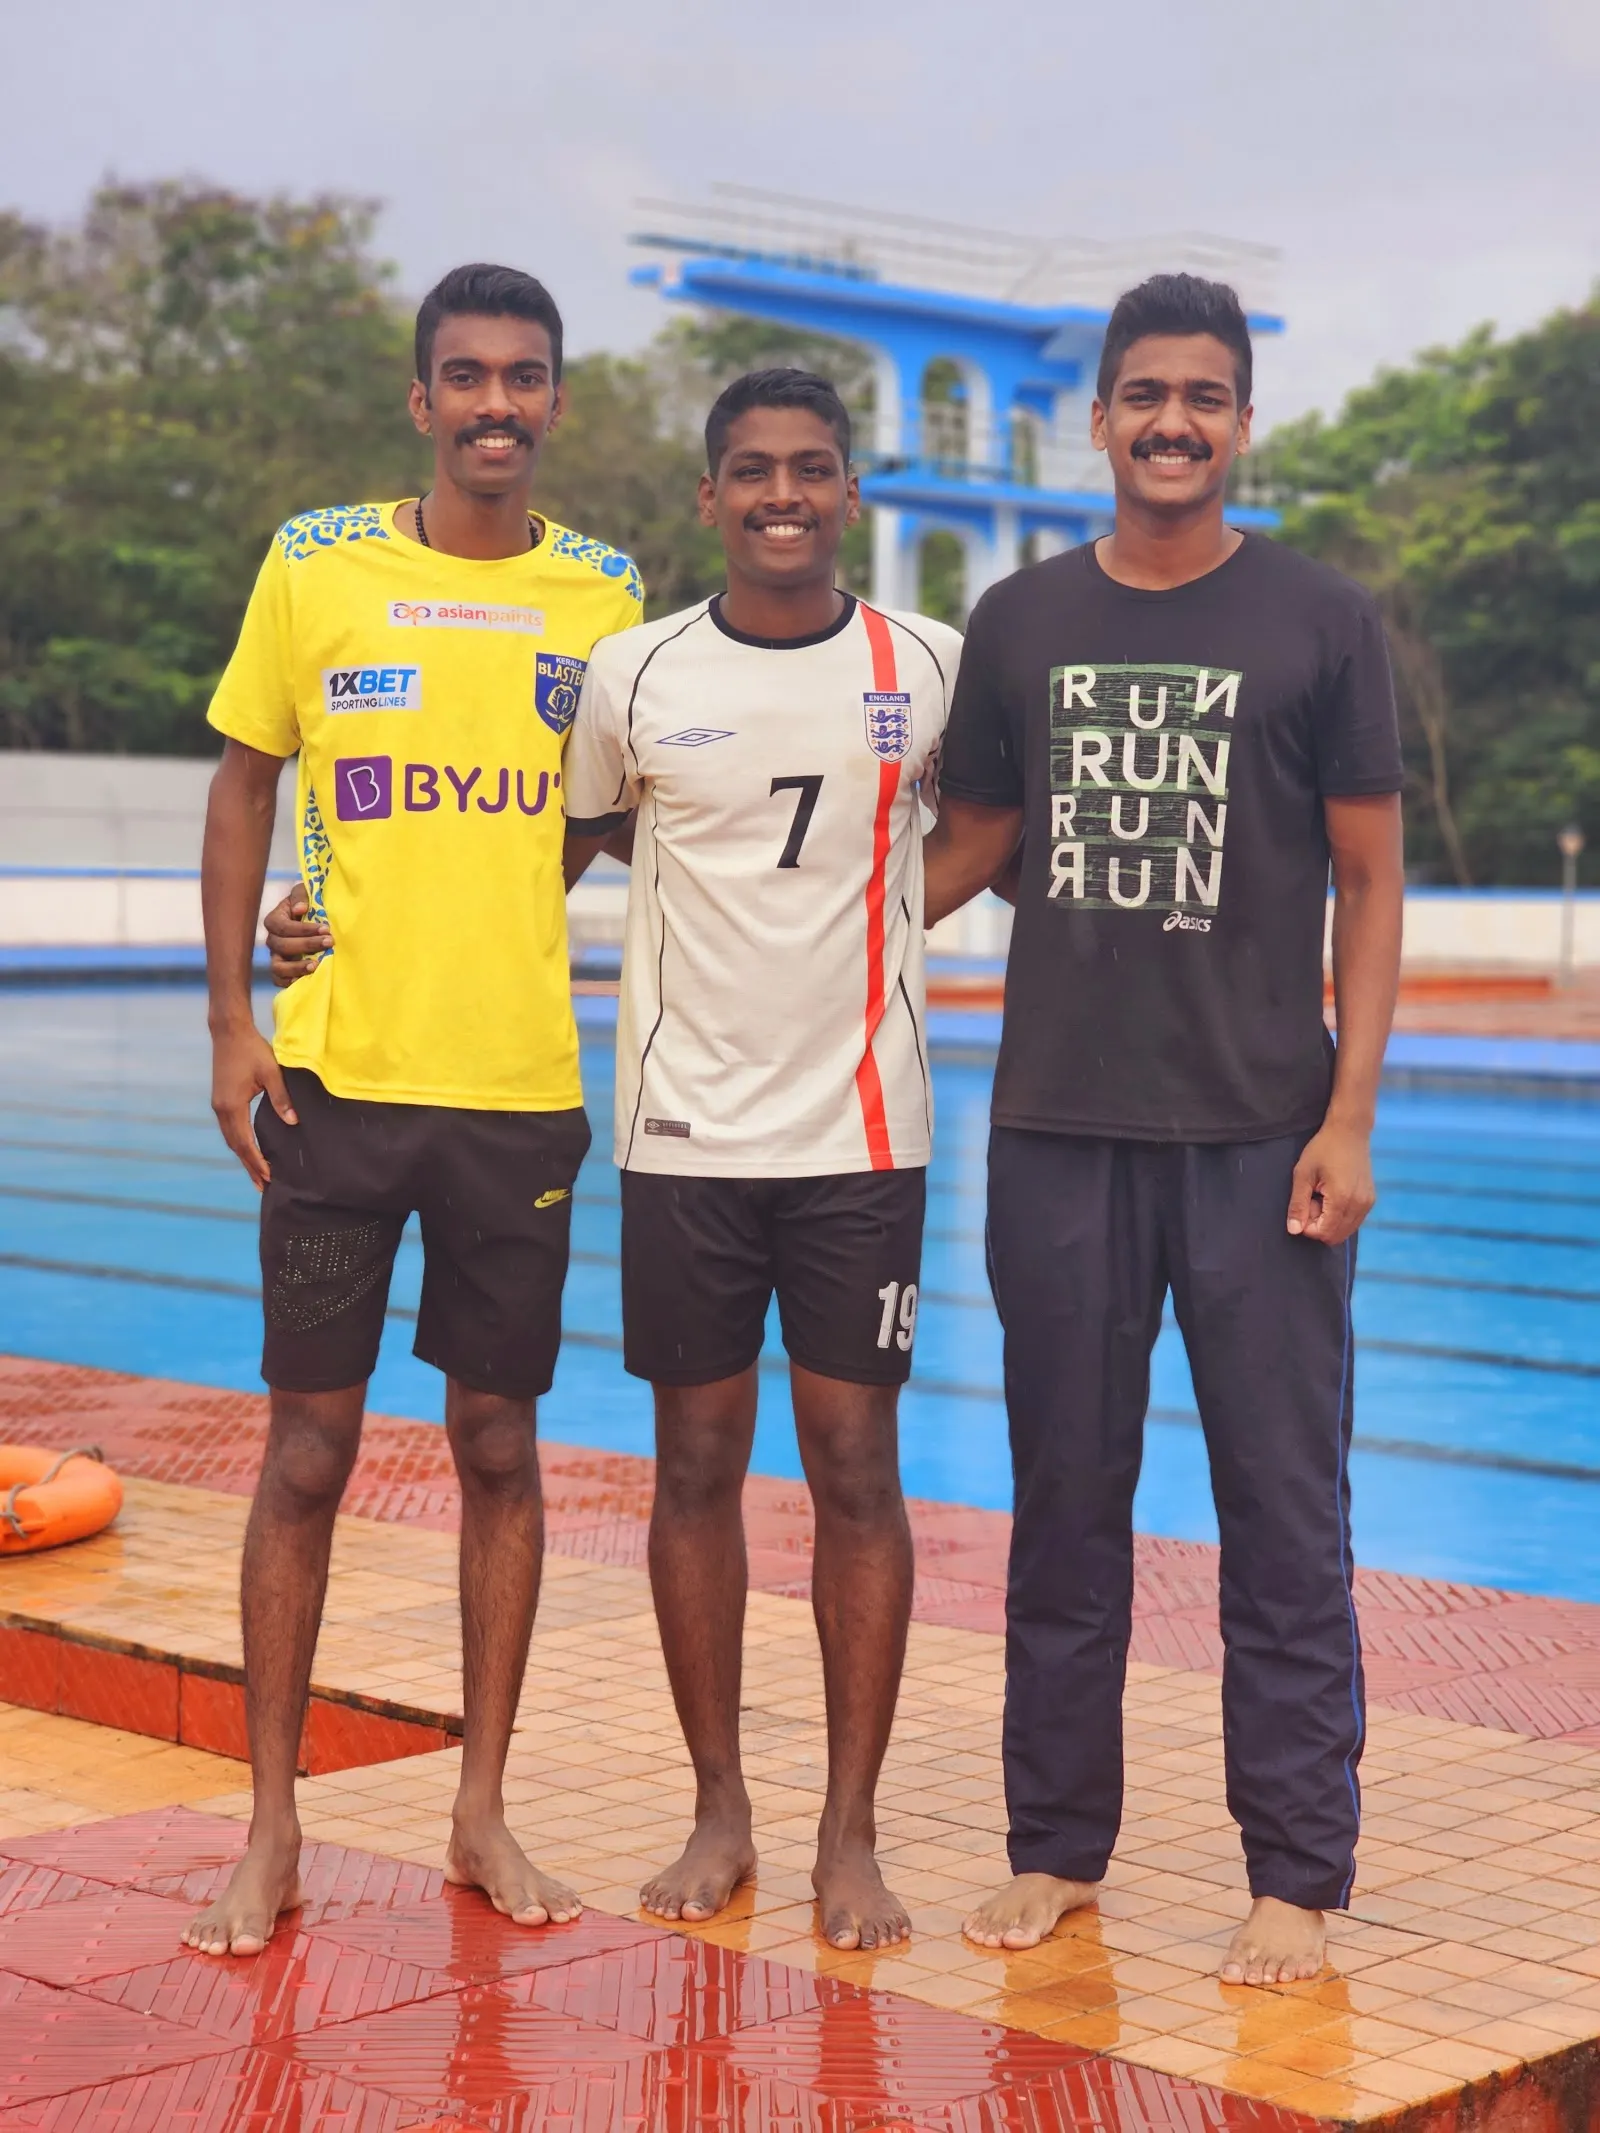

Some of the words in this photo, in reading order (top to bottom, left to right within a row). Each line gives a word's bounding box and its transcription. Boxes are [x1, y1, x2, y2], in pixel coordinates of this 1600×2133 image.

[329, 669, 417, 697] 1XBET
[555, 656, 582, 669] KERALA
[868, 694, 905, 703] ENGLAND
[1072, 731, 1230, 795] RUN
[404, 764, 565, 819] BYJU'
[770, 775, 824, 868] 7
[1051, 794, 1227, 847] RUN
[1047, 842, 1223, 906] RUN
[877, 1281, 918, 1351] 19
